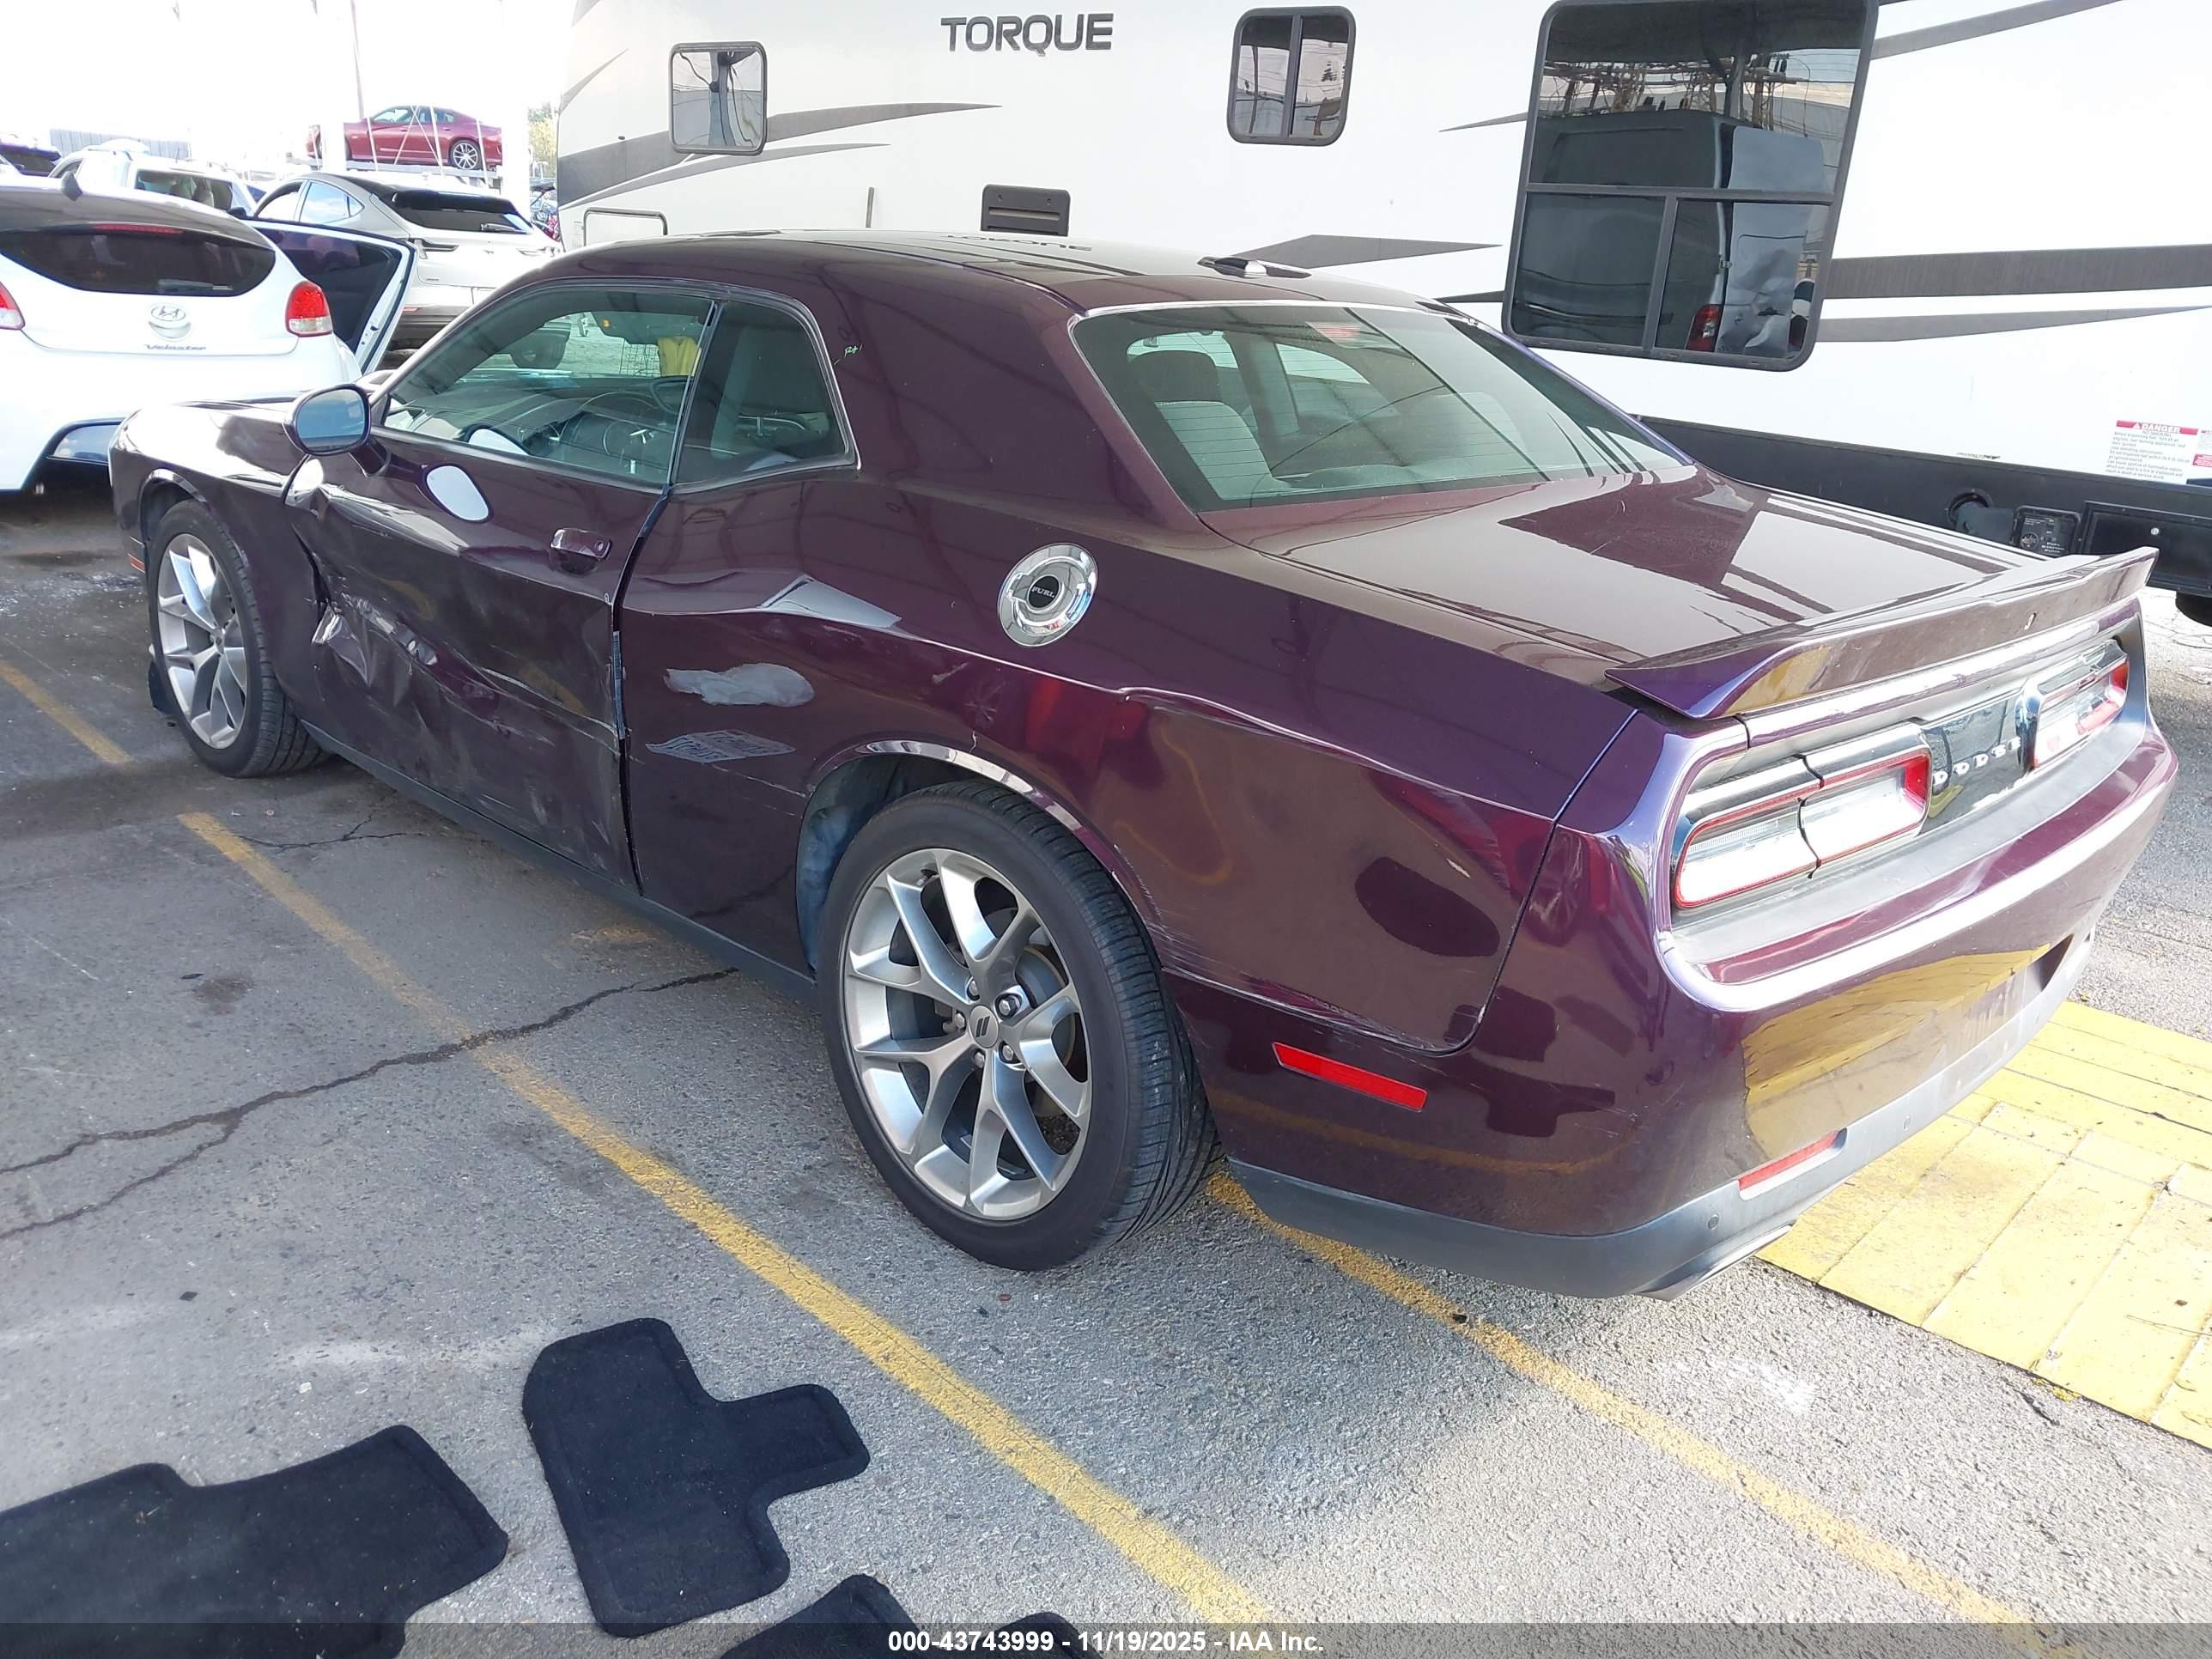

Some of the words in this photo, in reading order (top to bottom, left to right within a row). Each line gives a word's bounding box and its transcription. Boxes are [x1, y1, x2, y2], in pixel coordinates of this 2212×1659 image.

[940, 13, 1114, 57] TORQUE
[2142, 423, 2181, 434] DANGER
[1932, 736, 2021, 786] DODGE
